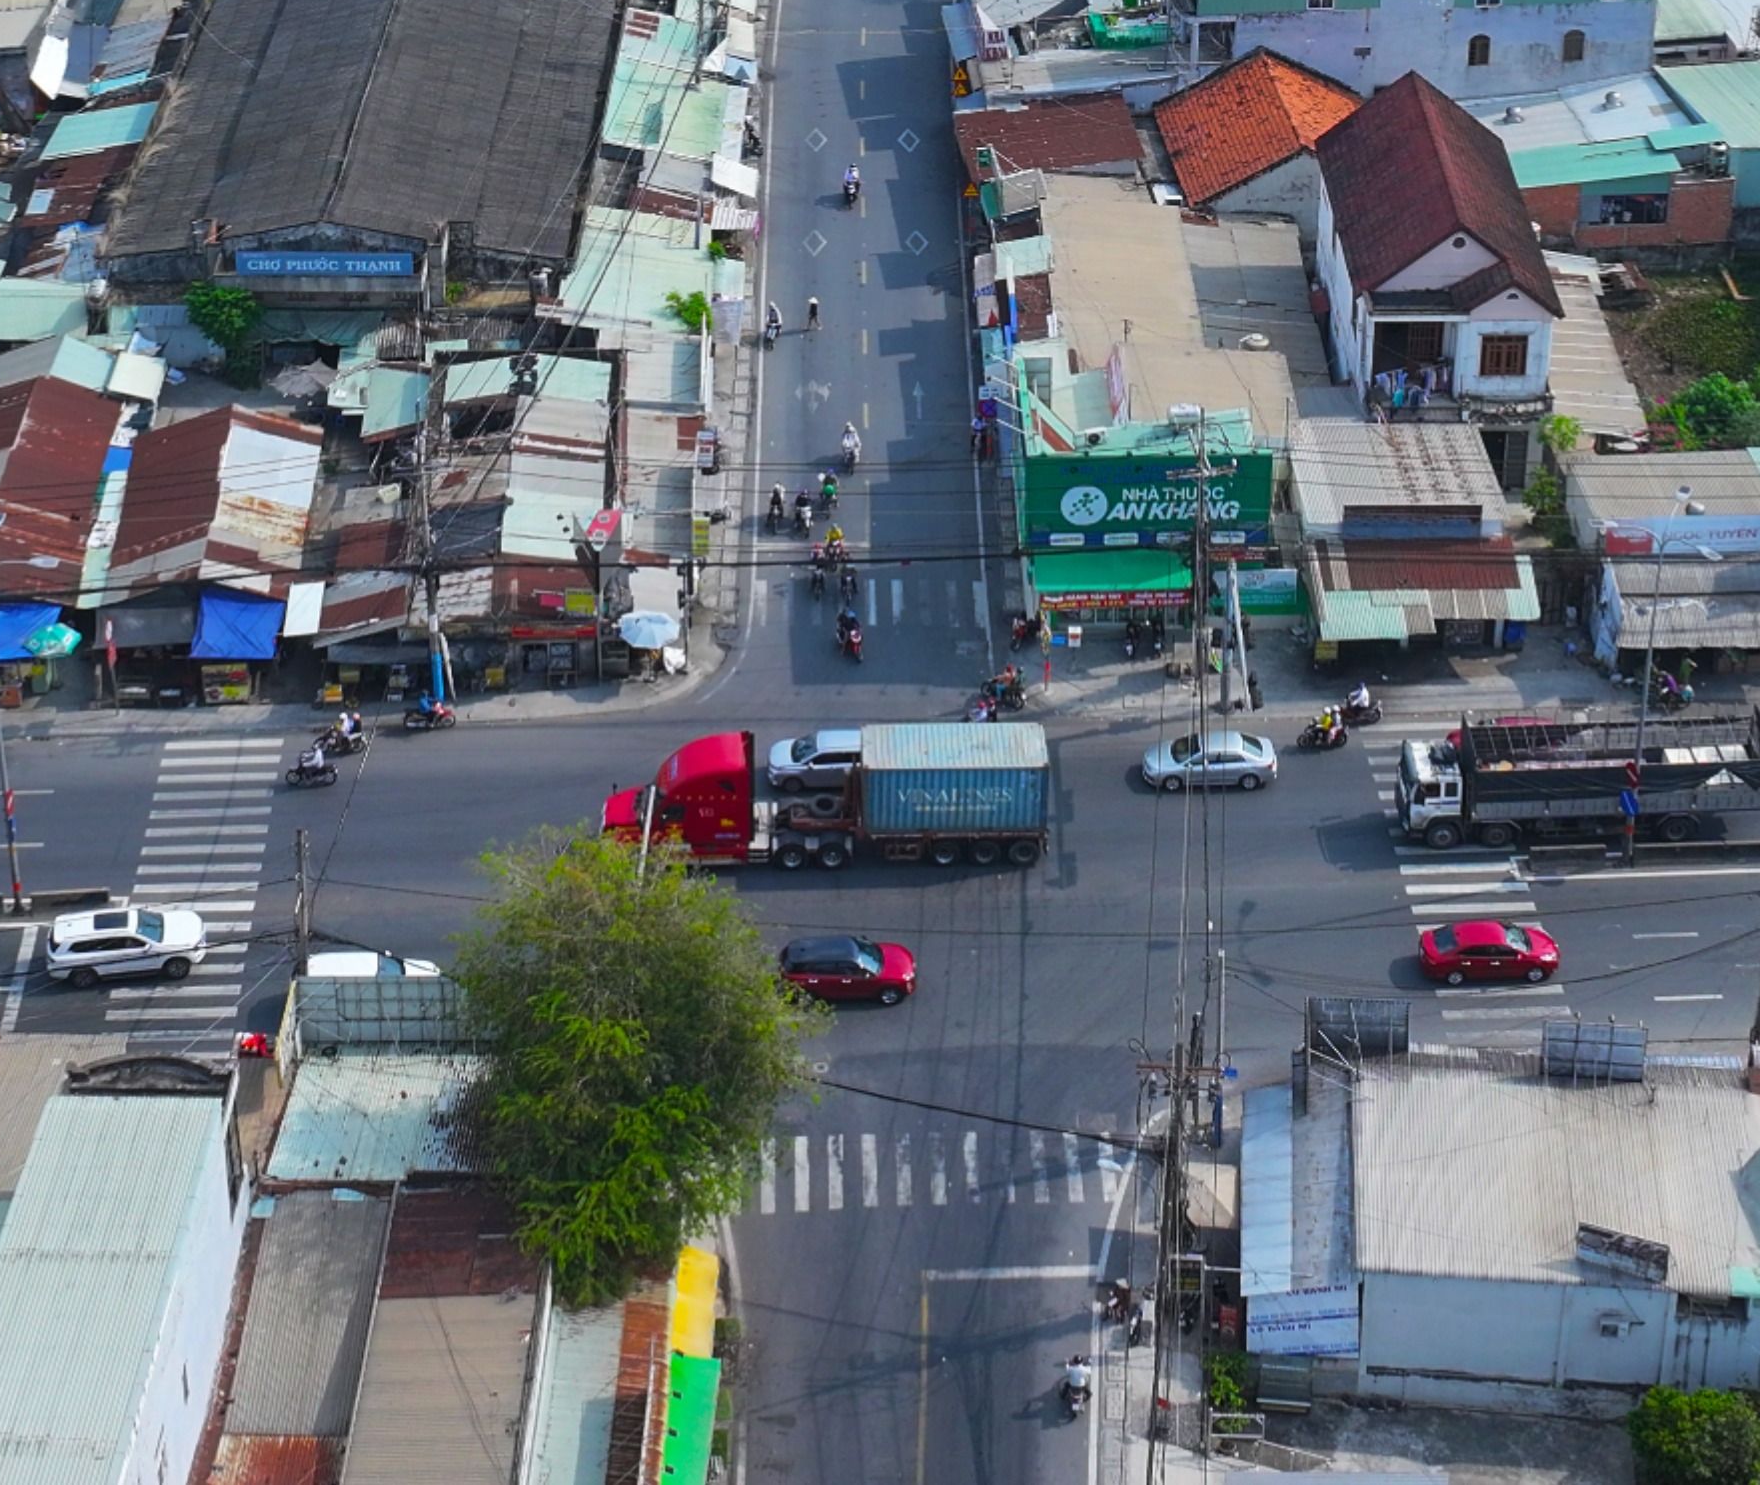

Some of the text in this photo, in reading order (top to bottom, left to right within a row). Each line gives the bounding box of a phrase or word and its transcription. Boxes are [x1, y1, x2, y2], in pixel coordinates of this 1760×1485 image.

[247, 256, 401, 274] CHỢ PHƯỚC THẠNH
[1122, 484, 1159, 501] NHÀ
[1106, 500, 1240, 521] AN KHANG
